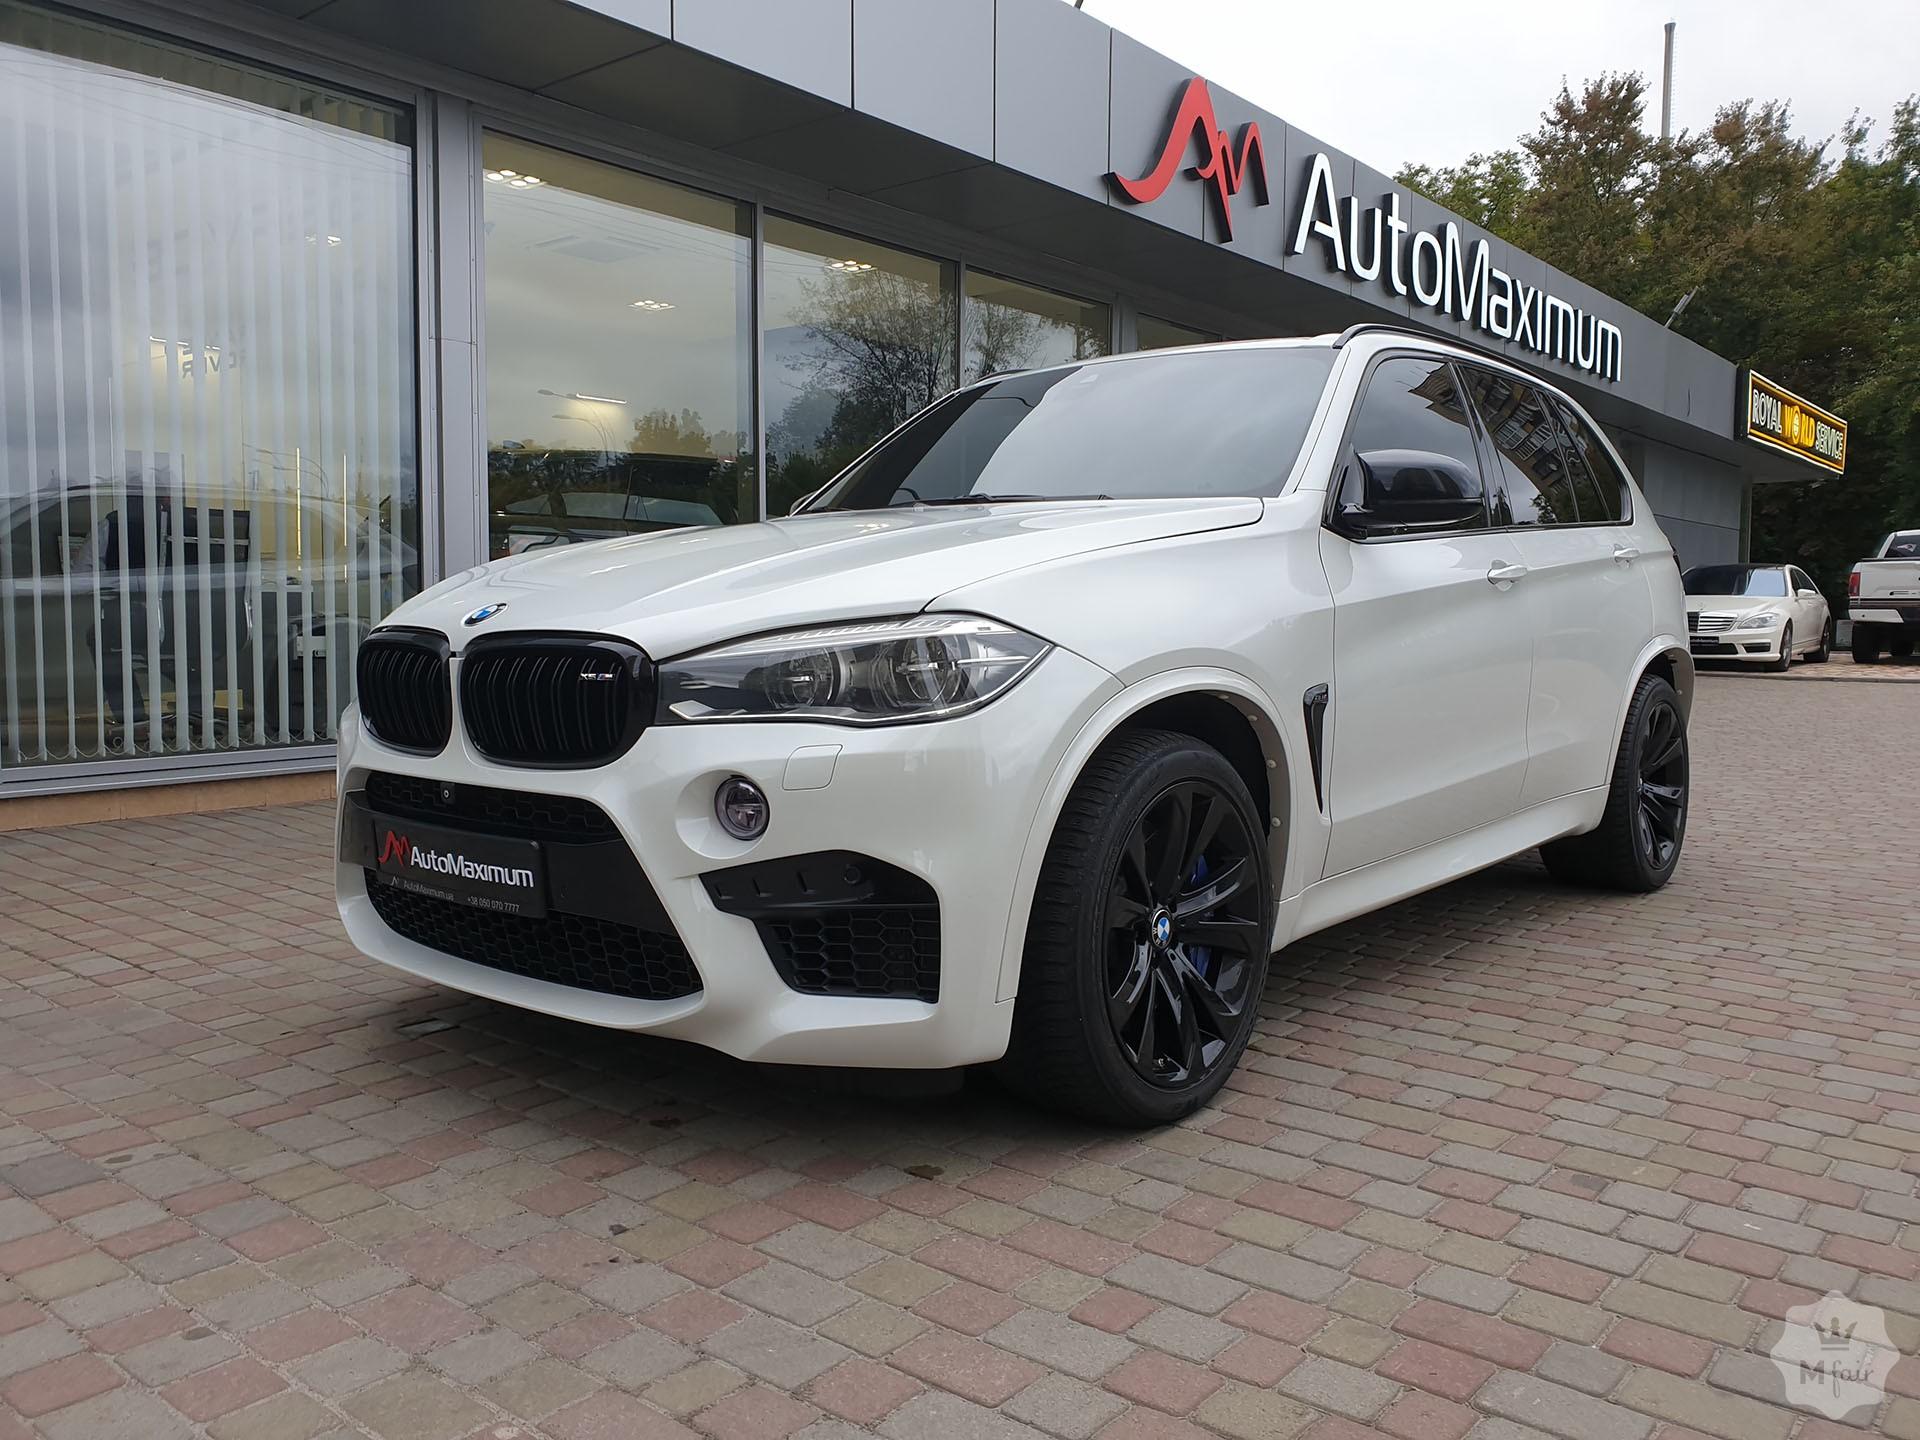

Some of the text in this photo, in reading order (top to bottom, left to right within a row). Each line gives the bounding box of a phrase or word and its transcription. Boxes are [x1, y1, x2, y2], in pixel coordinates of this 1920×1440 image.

[1291, 152, 1623, 382] AutoMaximum
[1752, 388, 1783, 434] ROYAL
[1815, 421, 1844, 460] SERVICE
[411, 846, 534, 888] AutoMaximum
